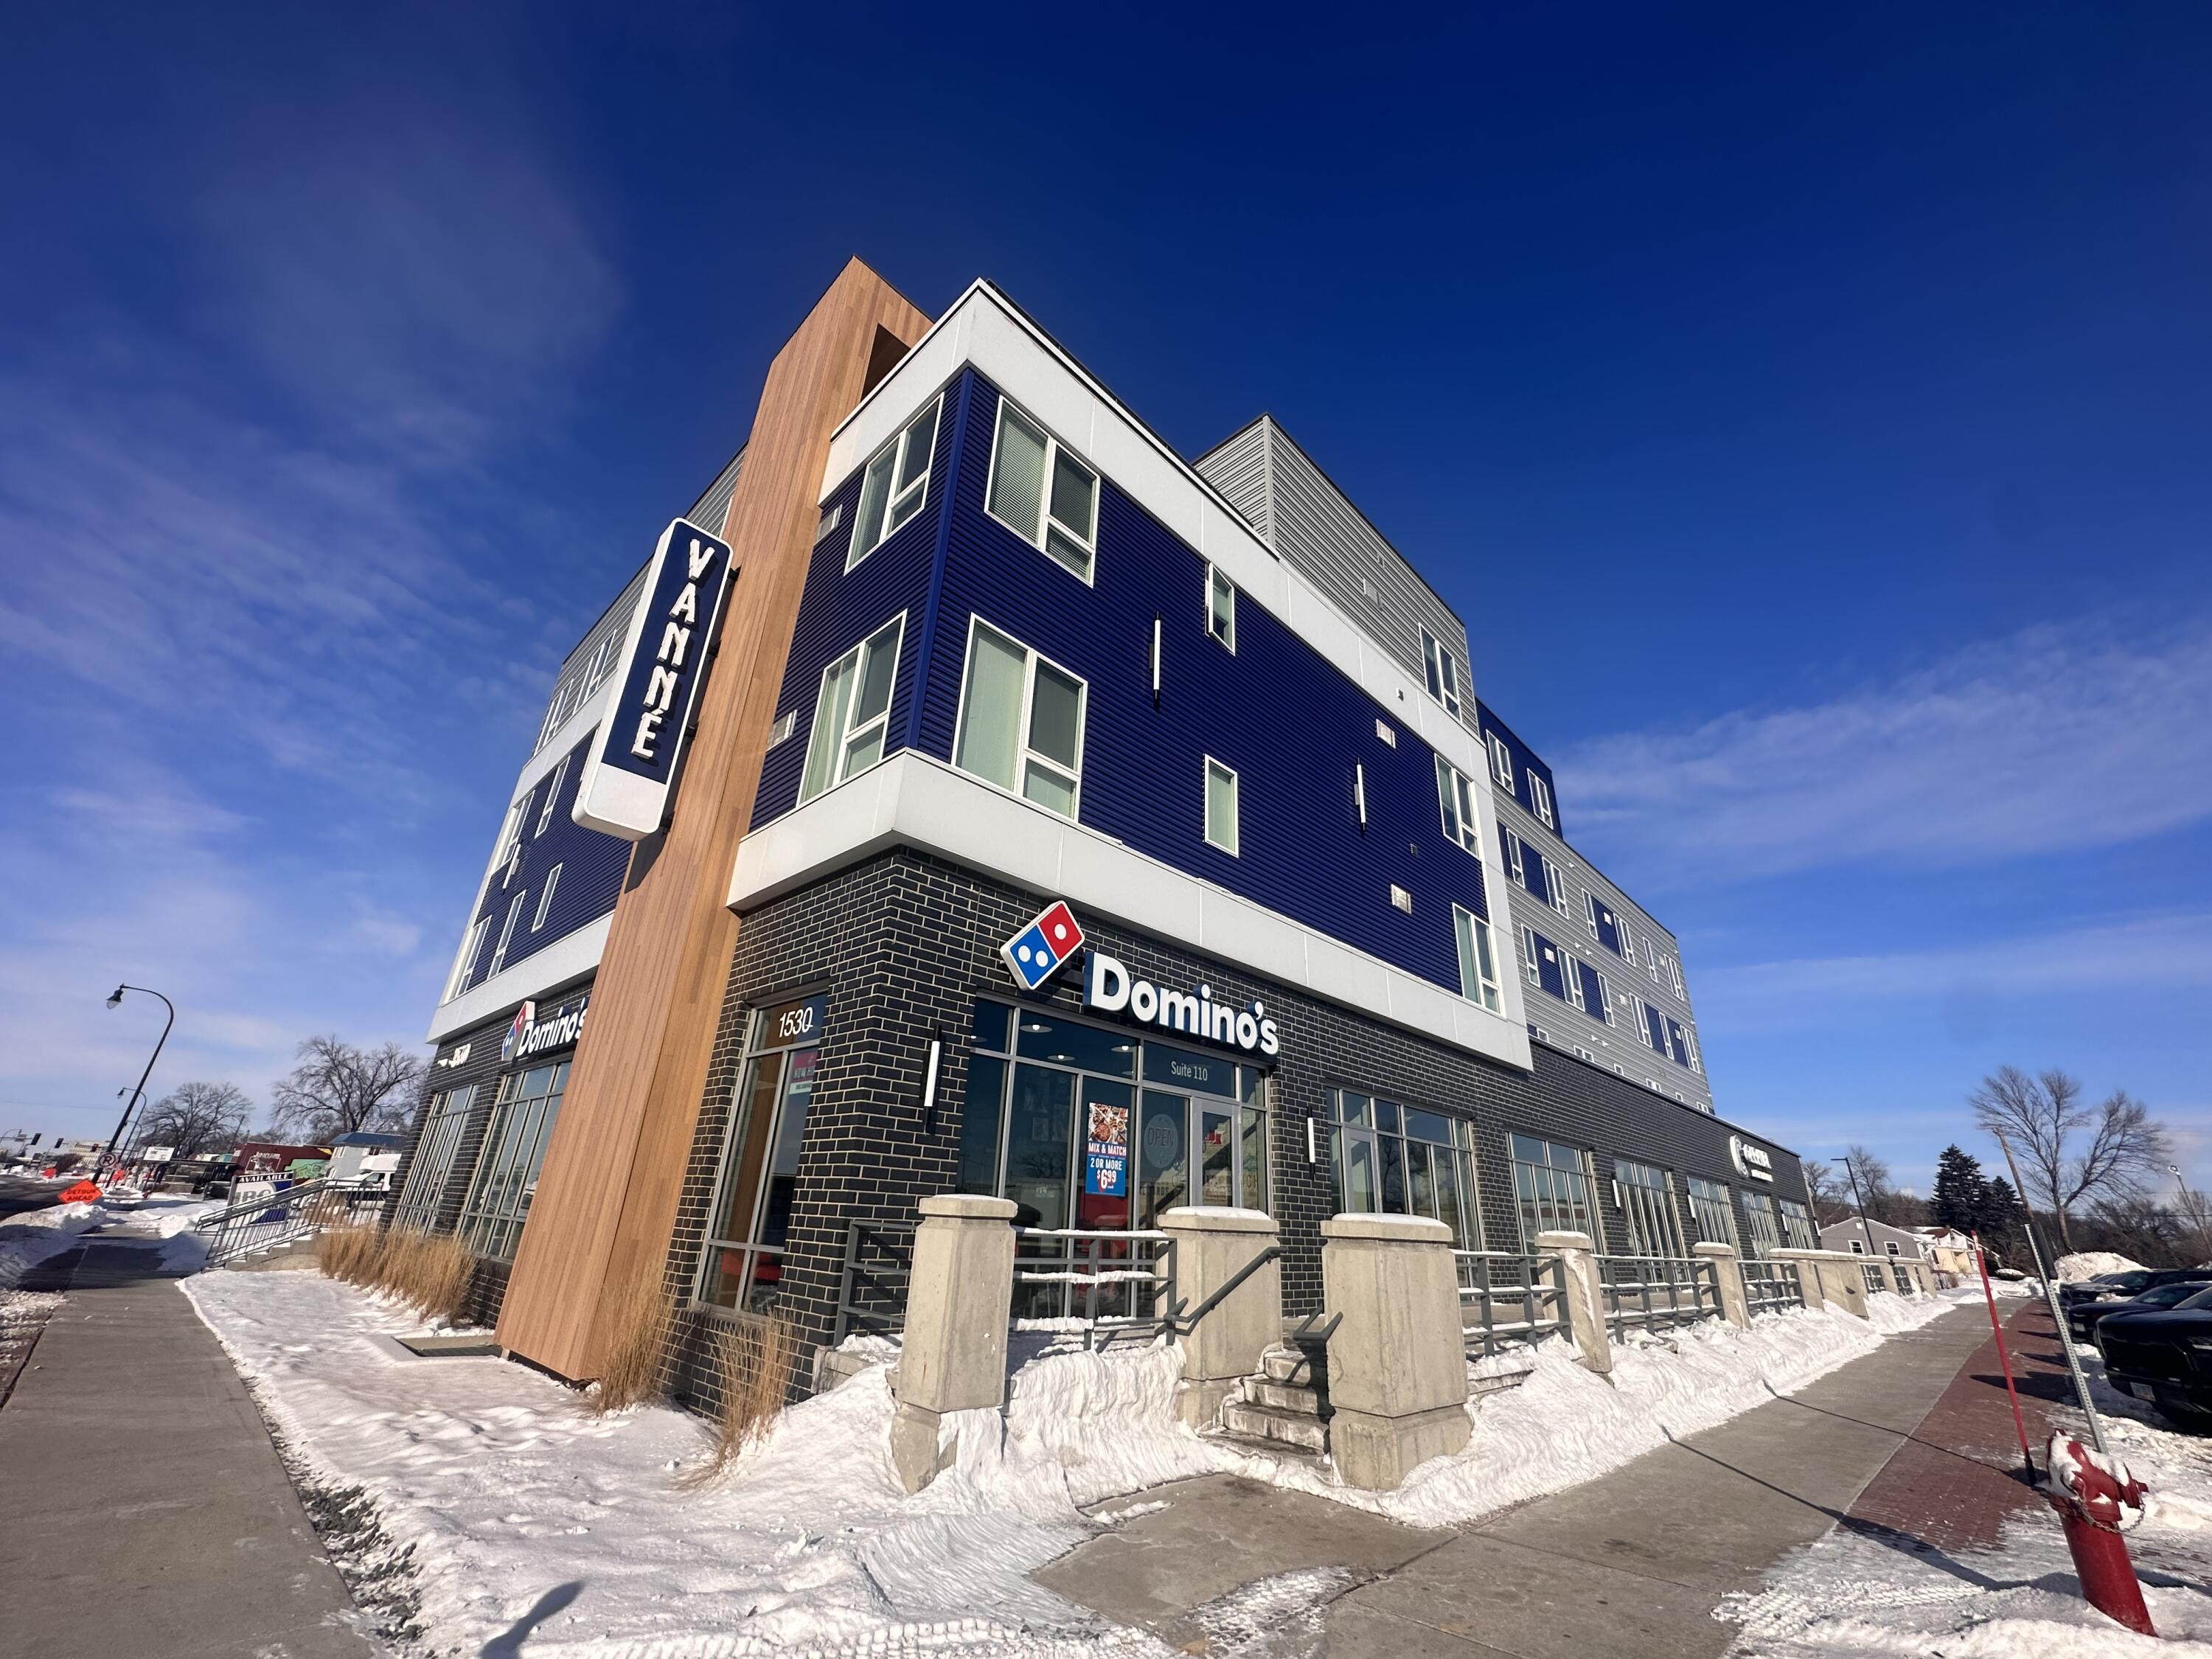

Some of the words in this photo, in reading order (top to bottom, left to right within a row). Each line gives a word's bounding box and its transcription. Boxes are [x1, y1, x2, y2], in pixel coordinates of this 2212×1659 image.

[1090, 951, 1279, 1055] Domino's
[779, 1006, 813, 1038] 1530
[1171, 1060, 1192, 1078] Suite
[1193, 1065, 1208, 1082] 110
[1147, 1127, 1174, 1148] OPEN
[1088, 1142, 1099, 1153] MIX
[1101, 1144, 1107, 1154] &
[1107, 1144, 1127, 1156] MATCH
[1091, 1158, 1095, 1168] 2
[1096, 1158, 1104, 1169] OR
[1105, 1158, 1122, 1170] MORE
[239, 1174, 288, 1183] AVAILABLE
